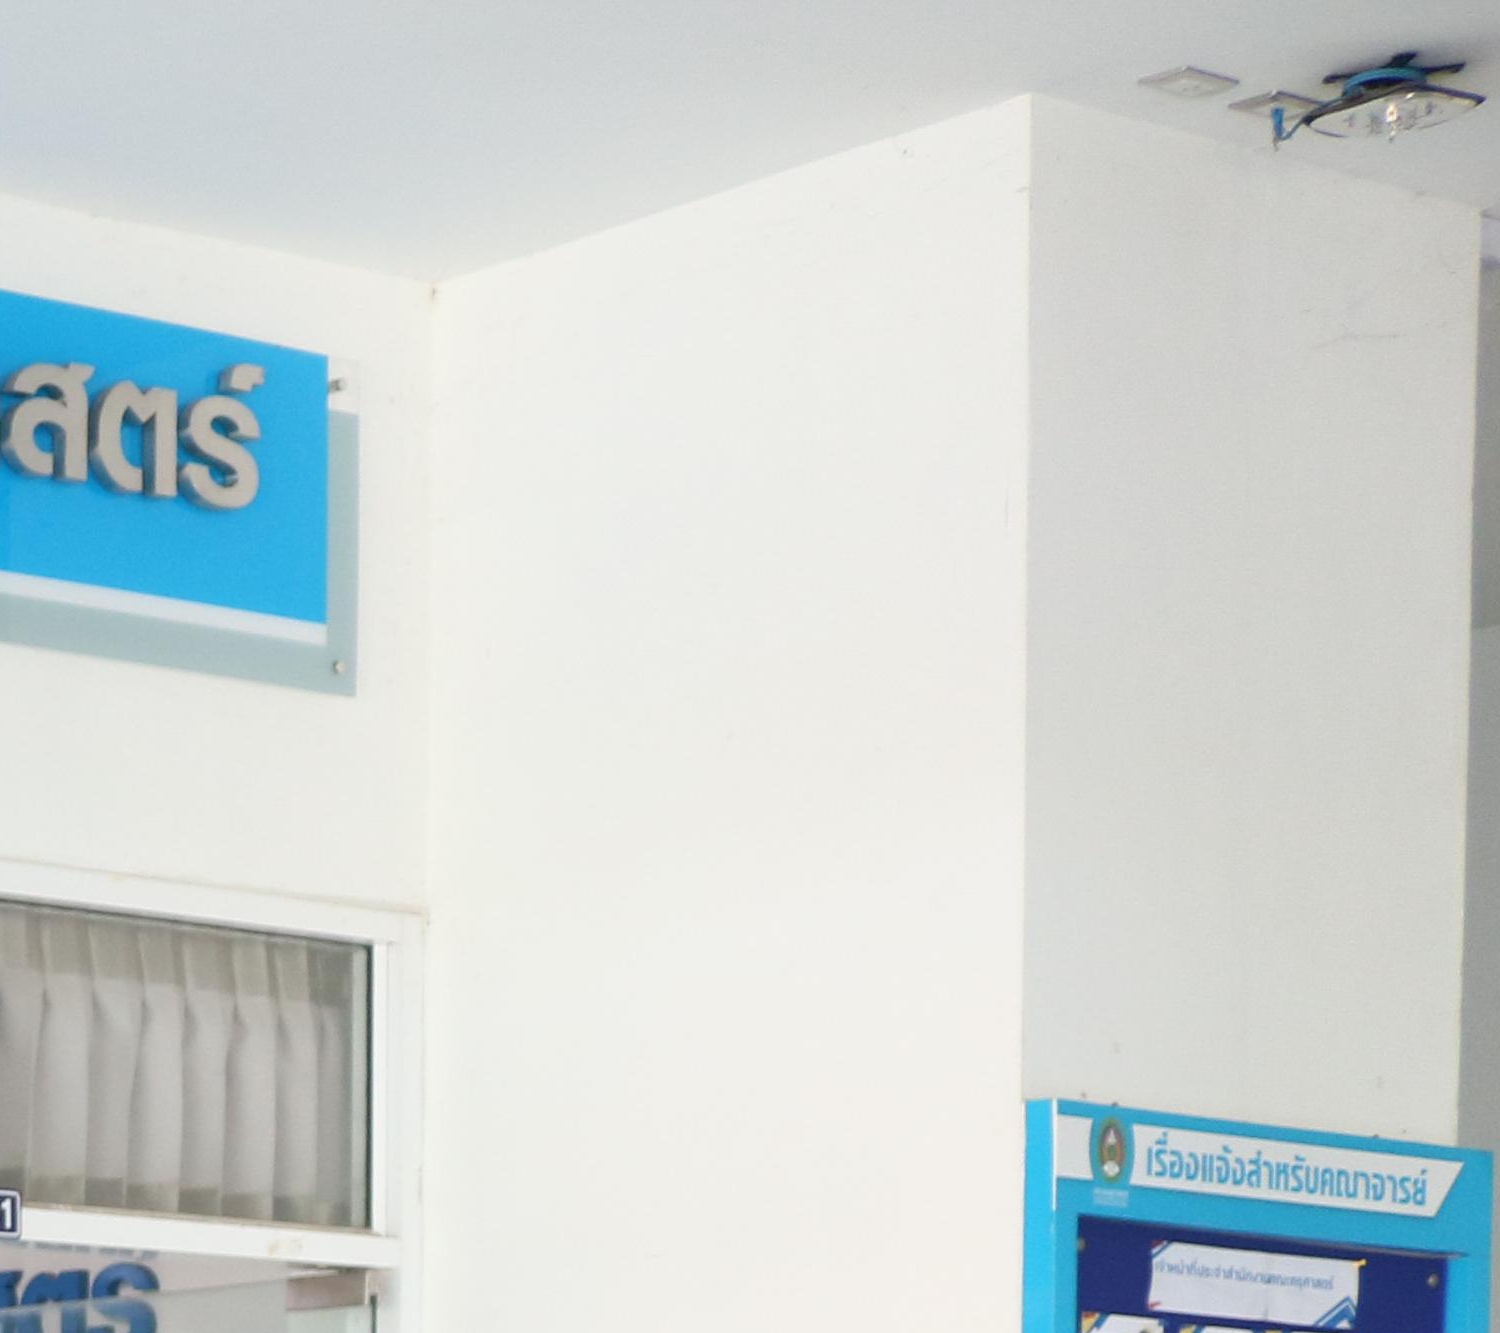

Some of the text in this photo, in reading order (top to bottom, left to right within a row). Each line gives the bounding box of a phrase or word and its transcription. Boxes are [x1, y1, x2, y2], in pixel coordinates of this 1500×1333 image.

[1146, 1131, 1429, 1206] เรื่องแจ้งสำหรับคณาจารย์
